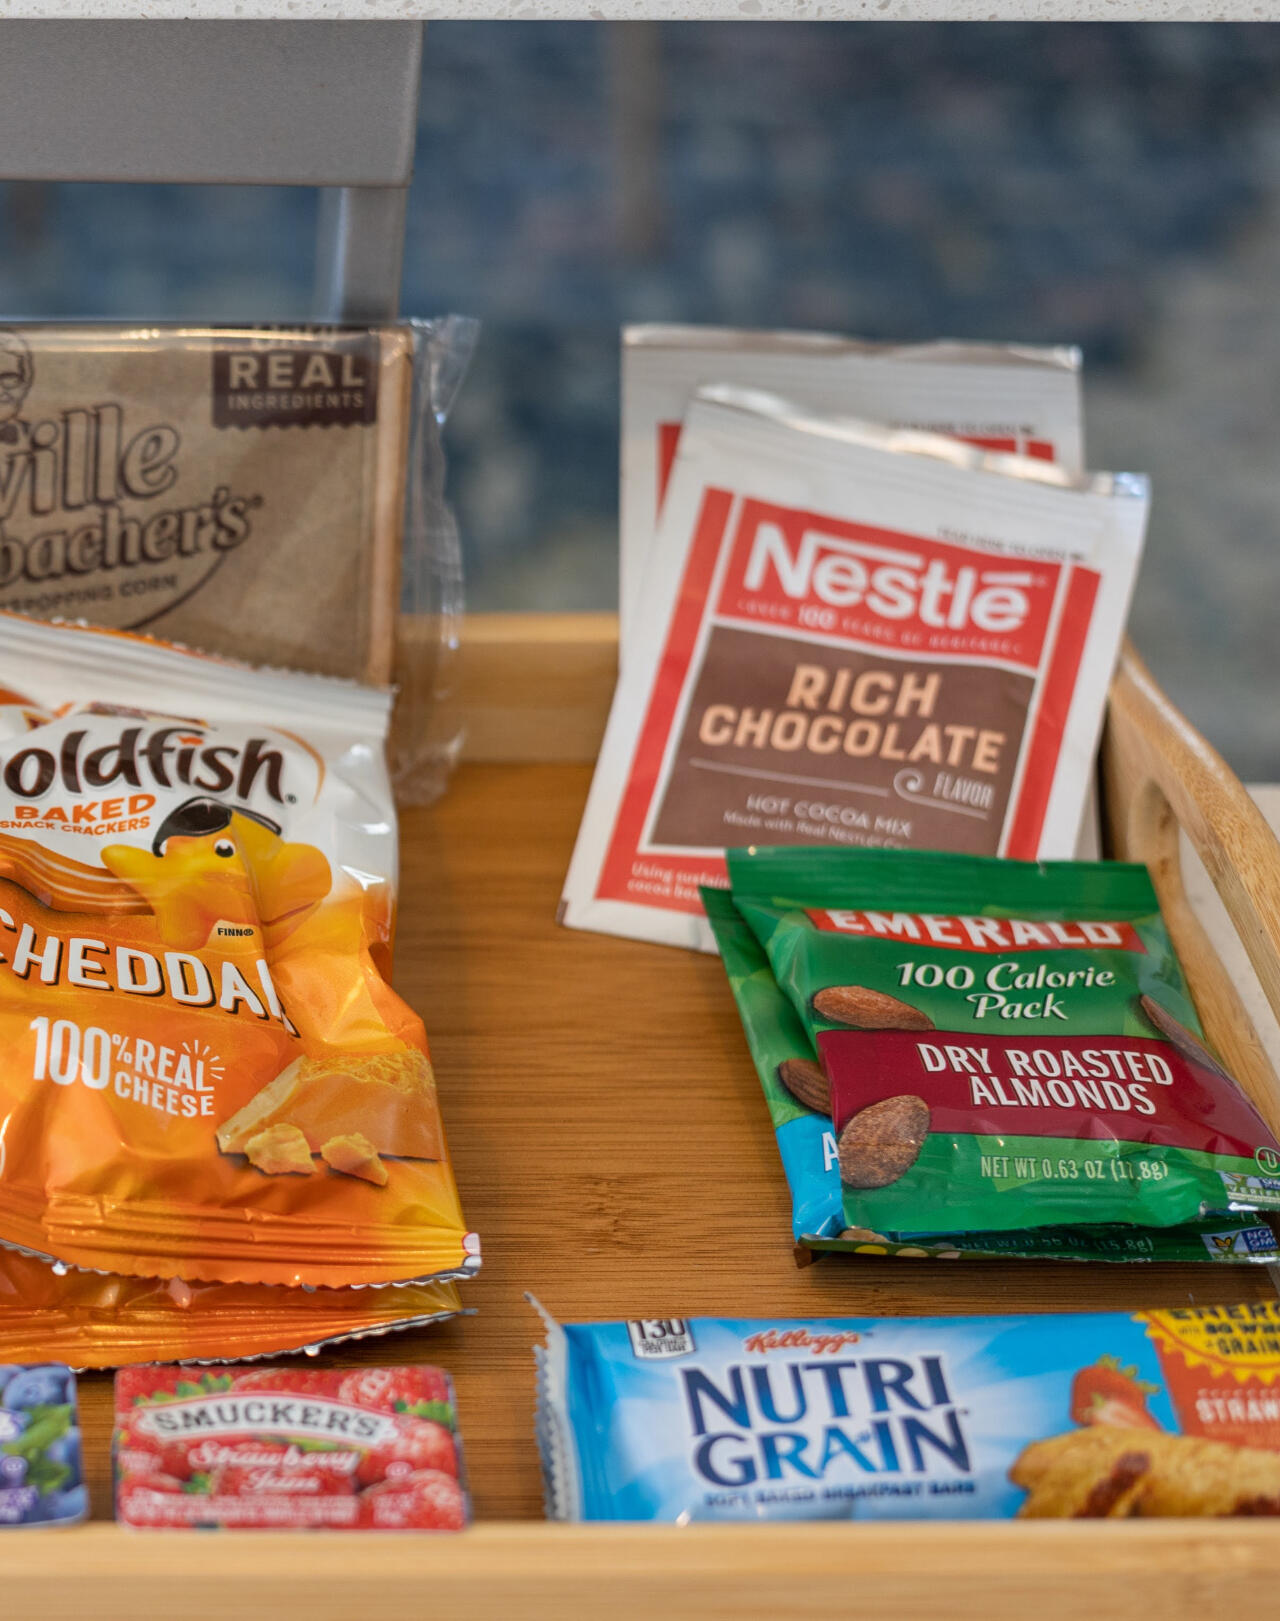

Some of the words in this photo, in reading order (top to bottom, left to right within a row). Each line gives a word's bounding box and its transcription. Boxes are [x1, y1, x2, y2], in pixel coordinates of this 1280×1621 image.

[229, 354, 364, 389] REAL
[228, 392, 363, 411] INGREDIENTS
[786, 663, 942, 719] RICH
[698, 703, 1008, 775] CHOCOLATE
[14, 793, 158, 824] BAKED
[933, 771, 995, 810] FLAVOR
[0, 820, 55, 830] SNACK
[61, 815, 151, 836] CRACKERS
[746, 794, 792, 815] HOT
[793, 801, 869, 829] COCOA
[873, 814, 914, 839] MIX
[627, 878, 671, 897] cocoa
[631, 862, 674, 883] Using
[675, 870, 732, 890] sustain
[824, 909, 1123, 948] EMERALD
[895, 962, 976, 990] 100
[984, 962, 1116, 994] Calorie
[965, 993, 1069, 1020] Pack
[134, 1038, 215, 1092] REAL
[915, 1043, 990, 1075] DRY
[1004, 1048, 1174, 1087] ROASTED
[114, 1071, 215, 1118] CHEESE
[969, 1075, 1157, 1117] ALMONDS
[980, 1155, 1010, 1180] NET
[1013, 1156, 1038, 1180] WT
[1041, 1158, 1080, 1181] 0.63
[1084, 1158, 1107, 1181] OZ
[744, 1328, 862, 1355] Kellogg's
[680, 1355, 953, 1436] NUTRI
[154, 1399, 382, 1438] SMUCKER'S
[187, 1441, 362, 1475] Strawberry
[694, 1408, 972, 1487] GRAIN
[821, 1484, 924, 1501] BREAKFAST
[927, 1480, 976, 1495] BARS
